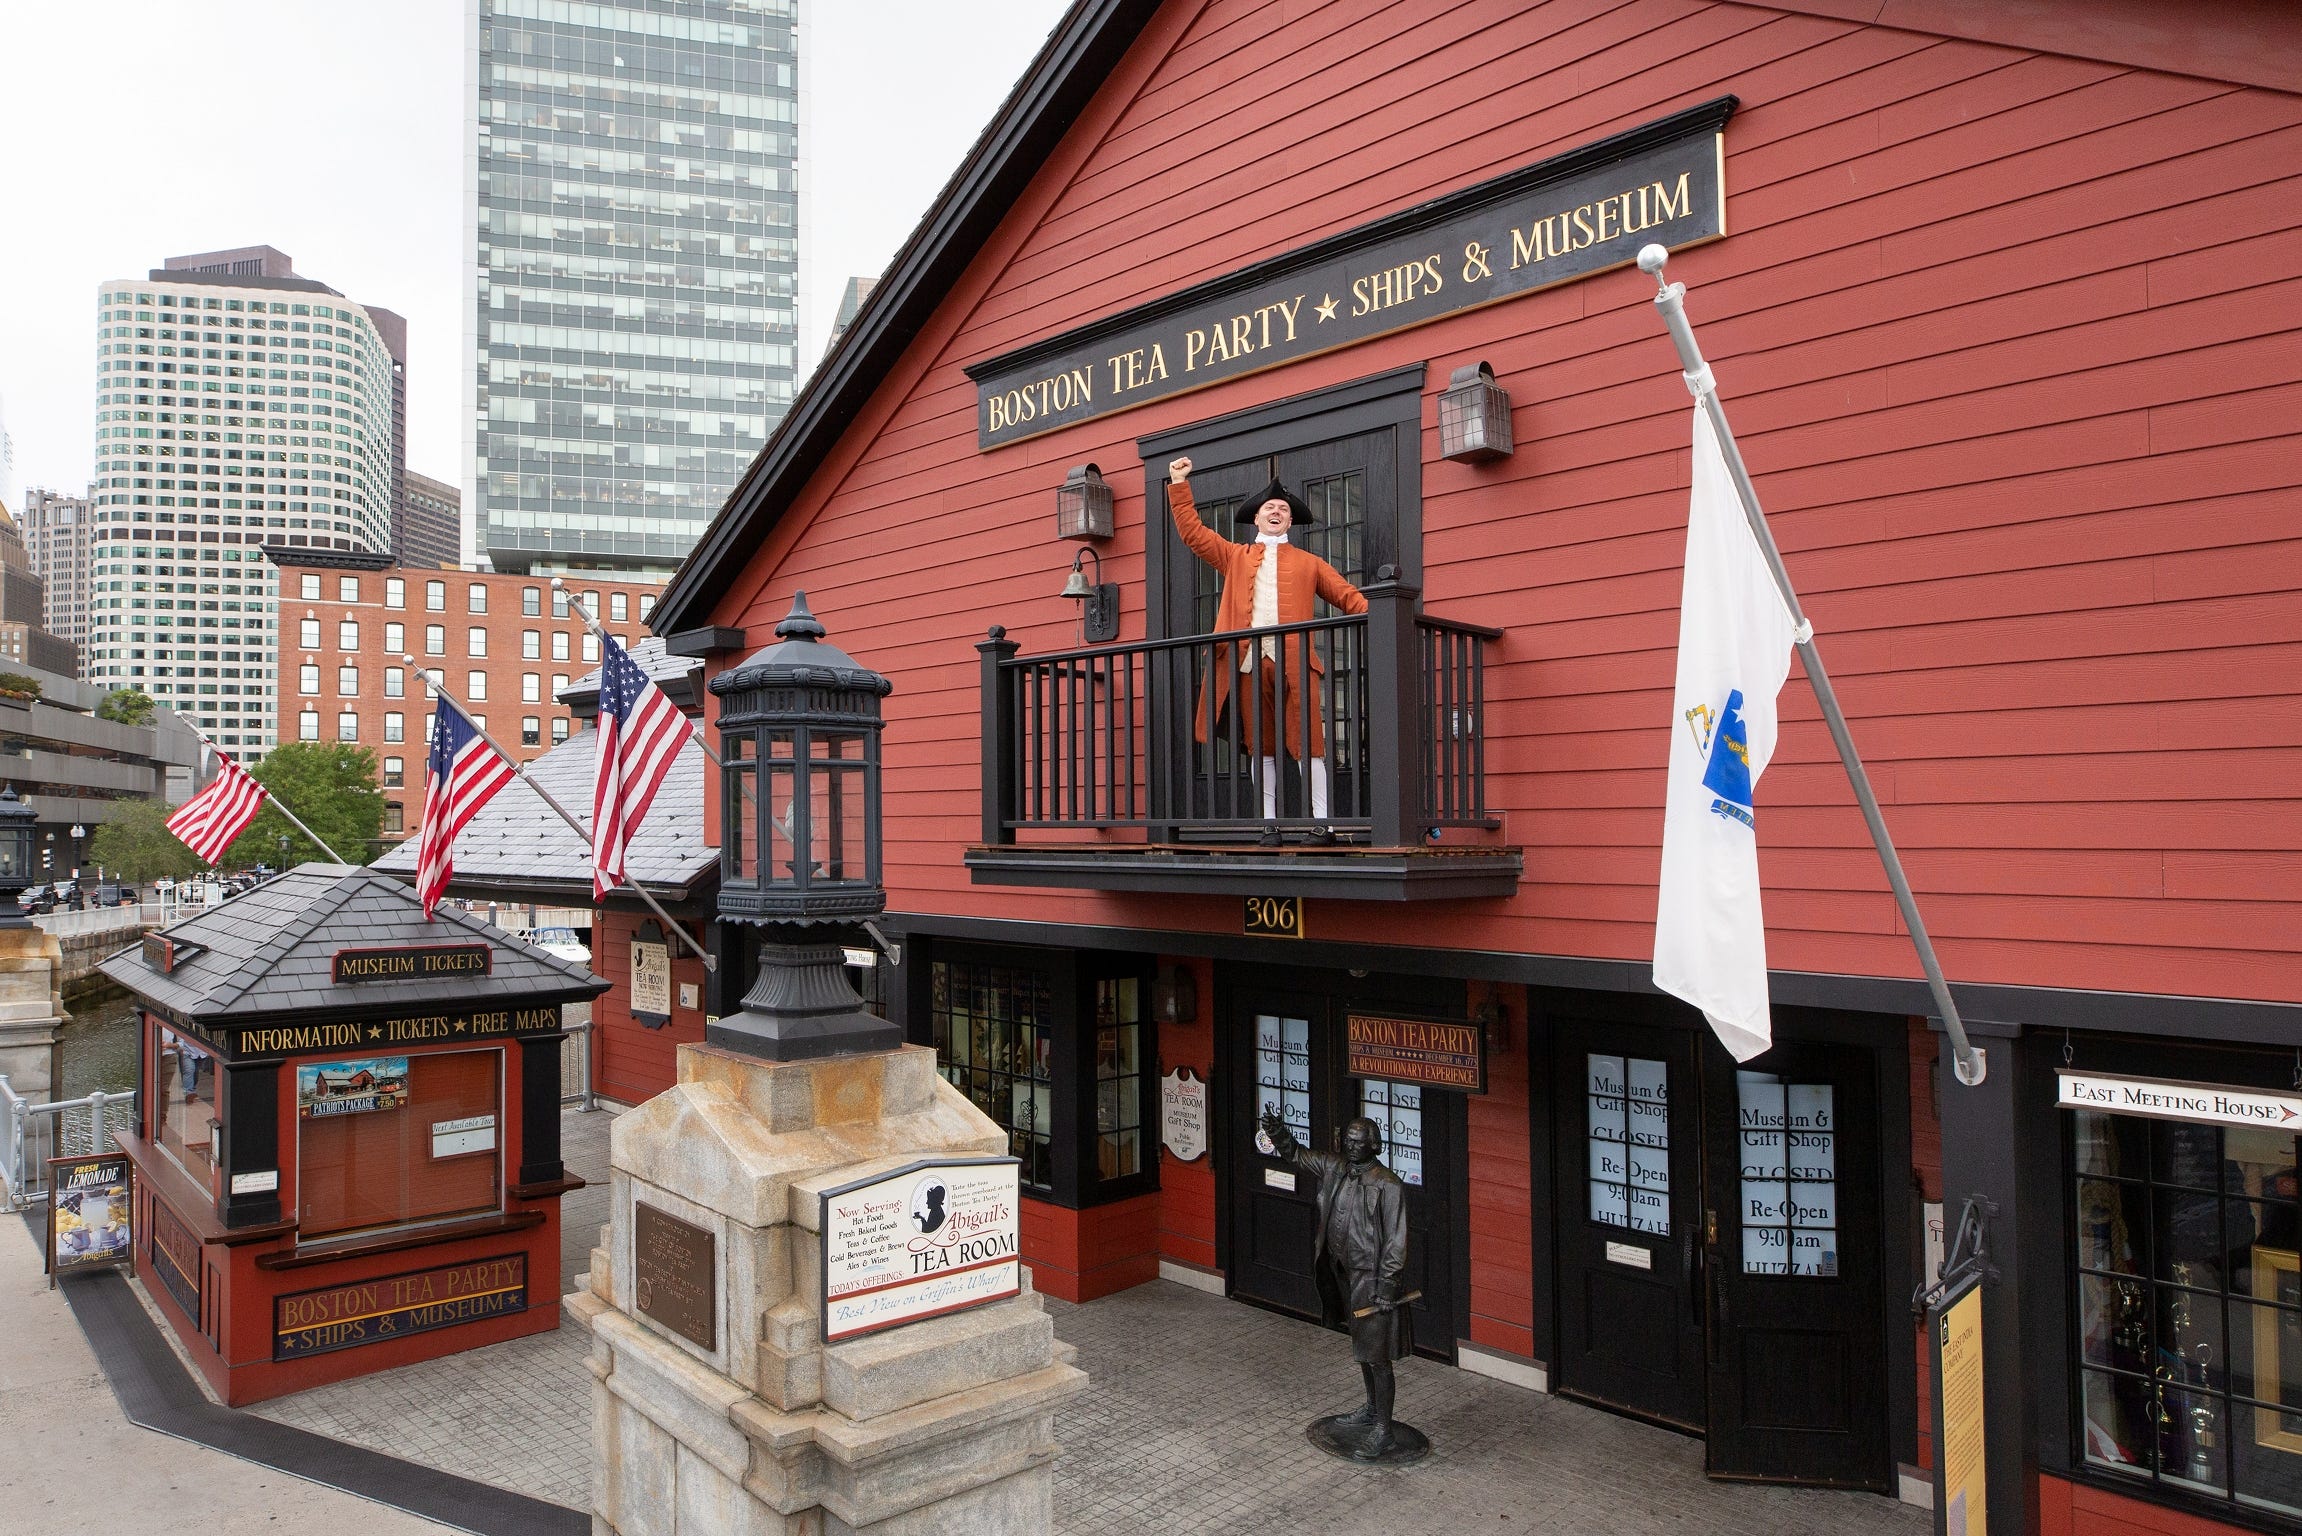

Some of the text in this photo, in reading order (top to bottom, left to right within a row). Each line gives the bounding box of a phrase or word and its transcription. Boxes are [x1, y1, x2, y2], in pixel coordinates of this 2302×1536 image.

[988, 172, 1693, 433] BOSTON TEA PARTY SHIPS & MUSEUM
[1246, 898, 1295, 929] 306
[341, 953, 484, 976] MUSEUM TICKETS
[636, 972, 665, 986] TEA ROOM
[241, 1008, 556, 1052] INFORMATION TICKETS FREE MAPS
[1350, 1019, 1476, 1054] BOSTON TEA PARTY
[1425, 1053, 1453, 1064] DECEMBER
[1352, 1057, 1474, 1083] A REVOLUTIONARY EXPERIENCE
[1594, 1076, 1651, 1097] Musum
[346, 1097, 375, 1112] PACKAGE
[1166, 1094, 1202, 1108] TEA ROOM
[2124, 1087, 2207, 1112] MEETING
[2214, 1096, 2277, 1119] HOUSE
[433, 1117, 495, 1133] Next Available Tour
[1168, 1116, 1200, 1131] Gift Shop
[1173, 1110, 1197, 1120] MUSEUM
[1816, 1110, 1829, 1127] &
[1744, 1130, 1830, 1153] Gift Shop
[67, 1167, 119, 1189] LEMONADE
[74, 1163, 99, 1175] FRESH
[1601, 1156, 1667, 1184] Re-Open
[836, 1200, 902, 1220] Now Serving:
[852, 1213, 884, 1226] Hot Foods
[949, 1203, 1009, 1231] Abigail's
[1750, 1200, 1828, 1224] Re-Open
[838, 1221, 897, 1239] Fresh Baked Goods
[830, 1253, 845, 1263] Cold
[847, 1247, 877, 1260] Beverages
[888, 1242, 905, 1251] Brews
[847, 1240, 860, 1249] Teas
[870, 1234, 890, 1244] Coffee
[847, 1256, 890, 1271] Ales & Wines
[909, 1232, 1015, 1274] TEA ROOM
[283, 1259, 521, 1328] BOSTON TEA PARTY
[830, 1270, 904, 1295] TODAY'S OFFERINGS:
[837, 1305, 865, 1320] Best
[870, 1296, 901, 1314] View
[903, 1294, 916, 1305] on
[919, 1277, 964, 1304] Griffin's
[300, 1294, 504, 1349] SHIPS & MUSEUM
